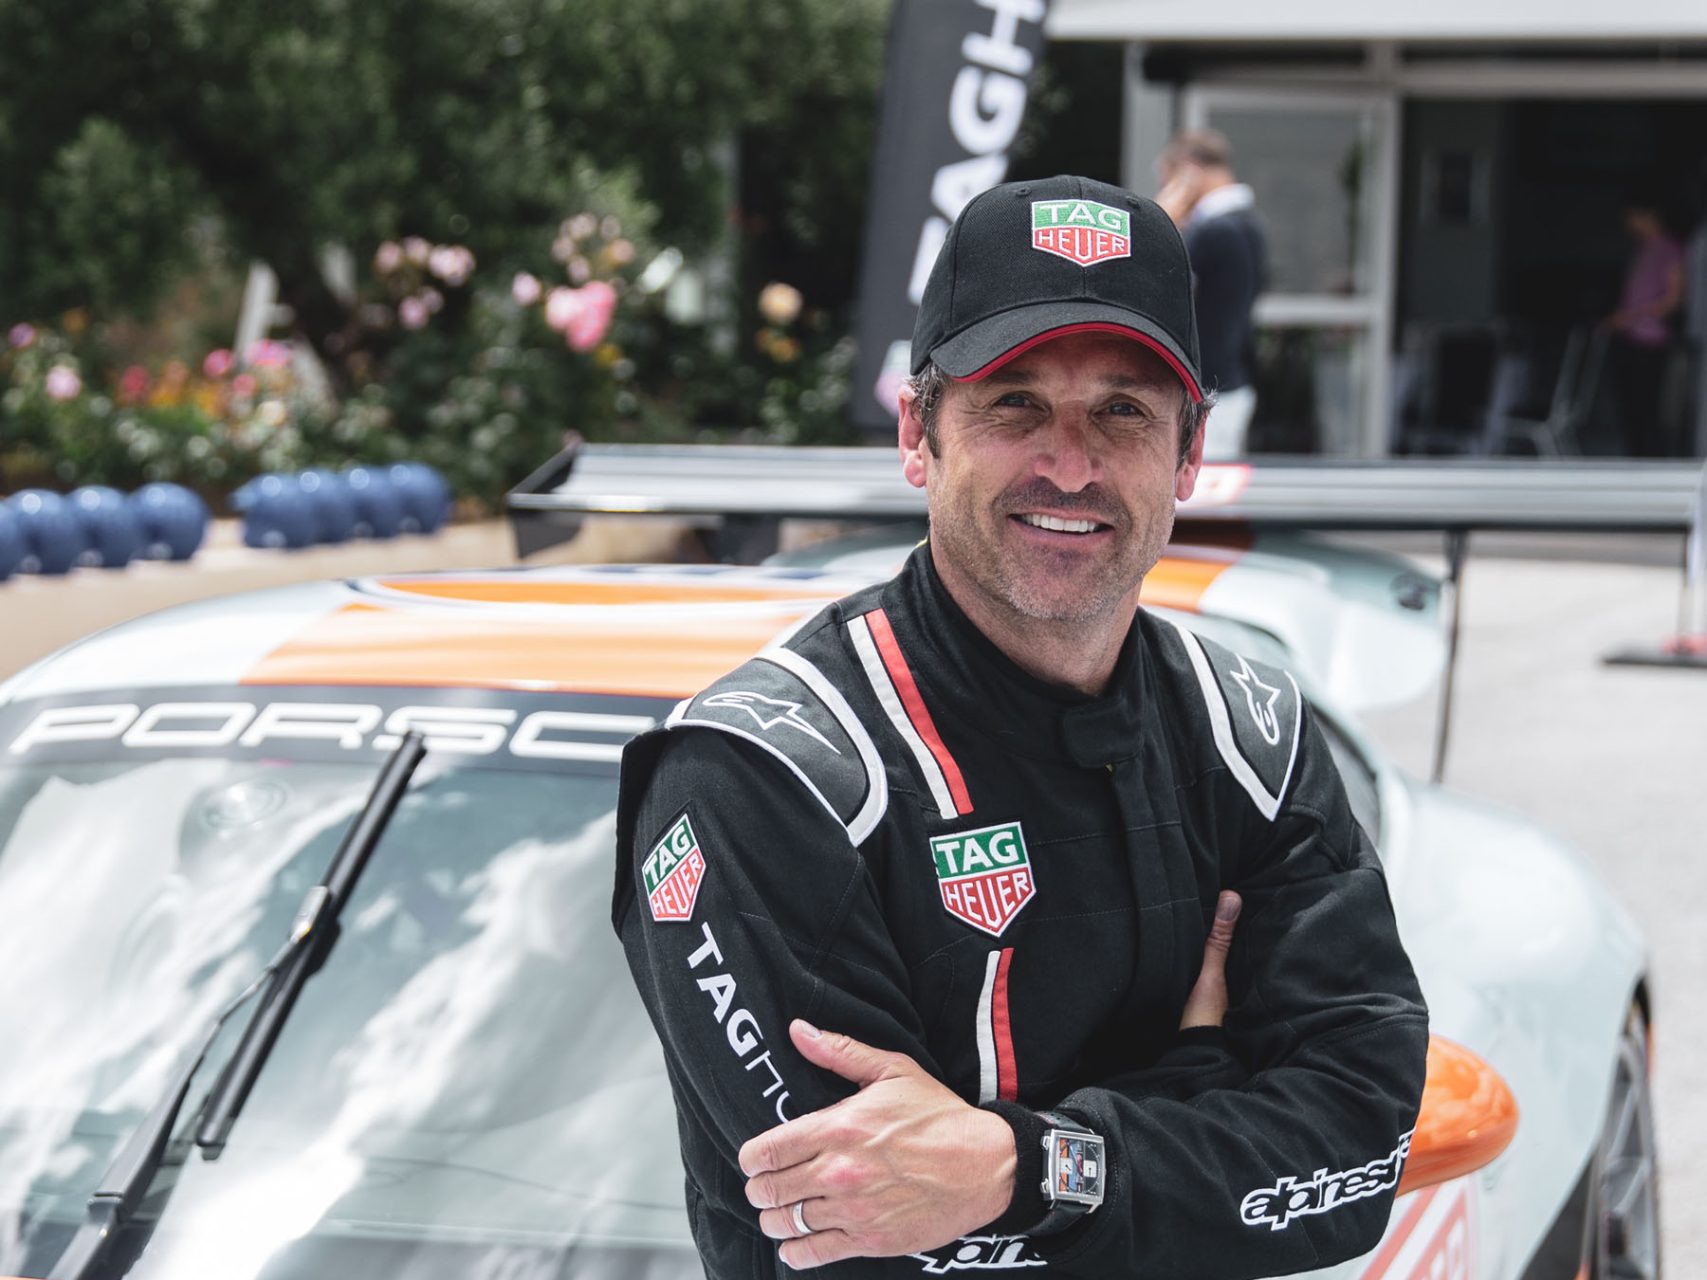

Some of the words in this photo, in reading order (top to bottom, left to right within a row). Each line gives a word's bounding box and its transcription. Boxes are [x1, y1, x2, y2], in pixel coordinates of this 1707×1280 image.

[1039, 202, 1121, 230] TAG
[1038, 229, 1125, 260] HEUER
[645, 824, 691, 886] TAG
[935, 831, 1019, 874] TAG
[651, 853, 701, 914] HEUER
[945, 872, 1029, 928] HEUER
